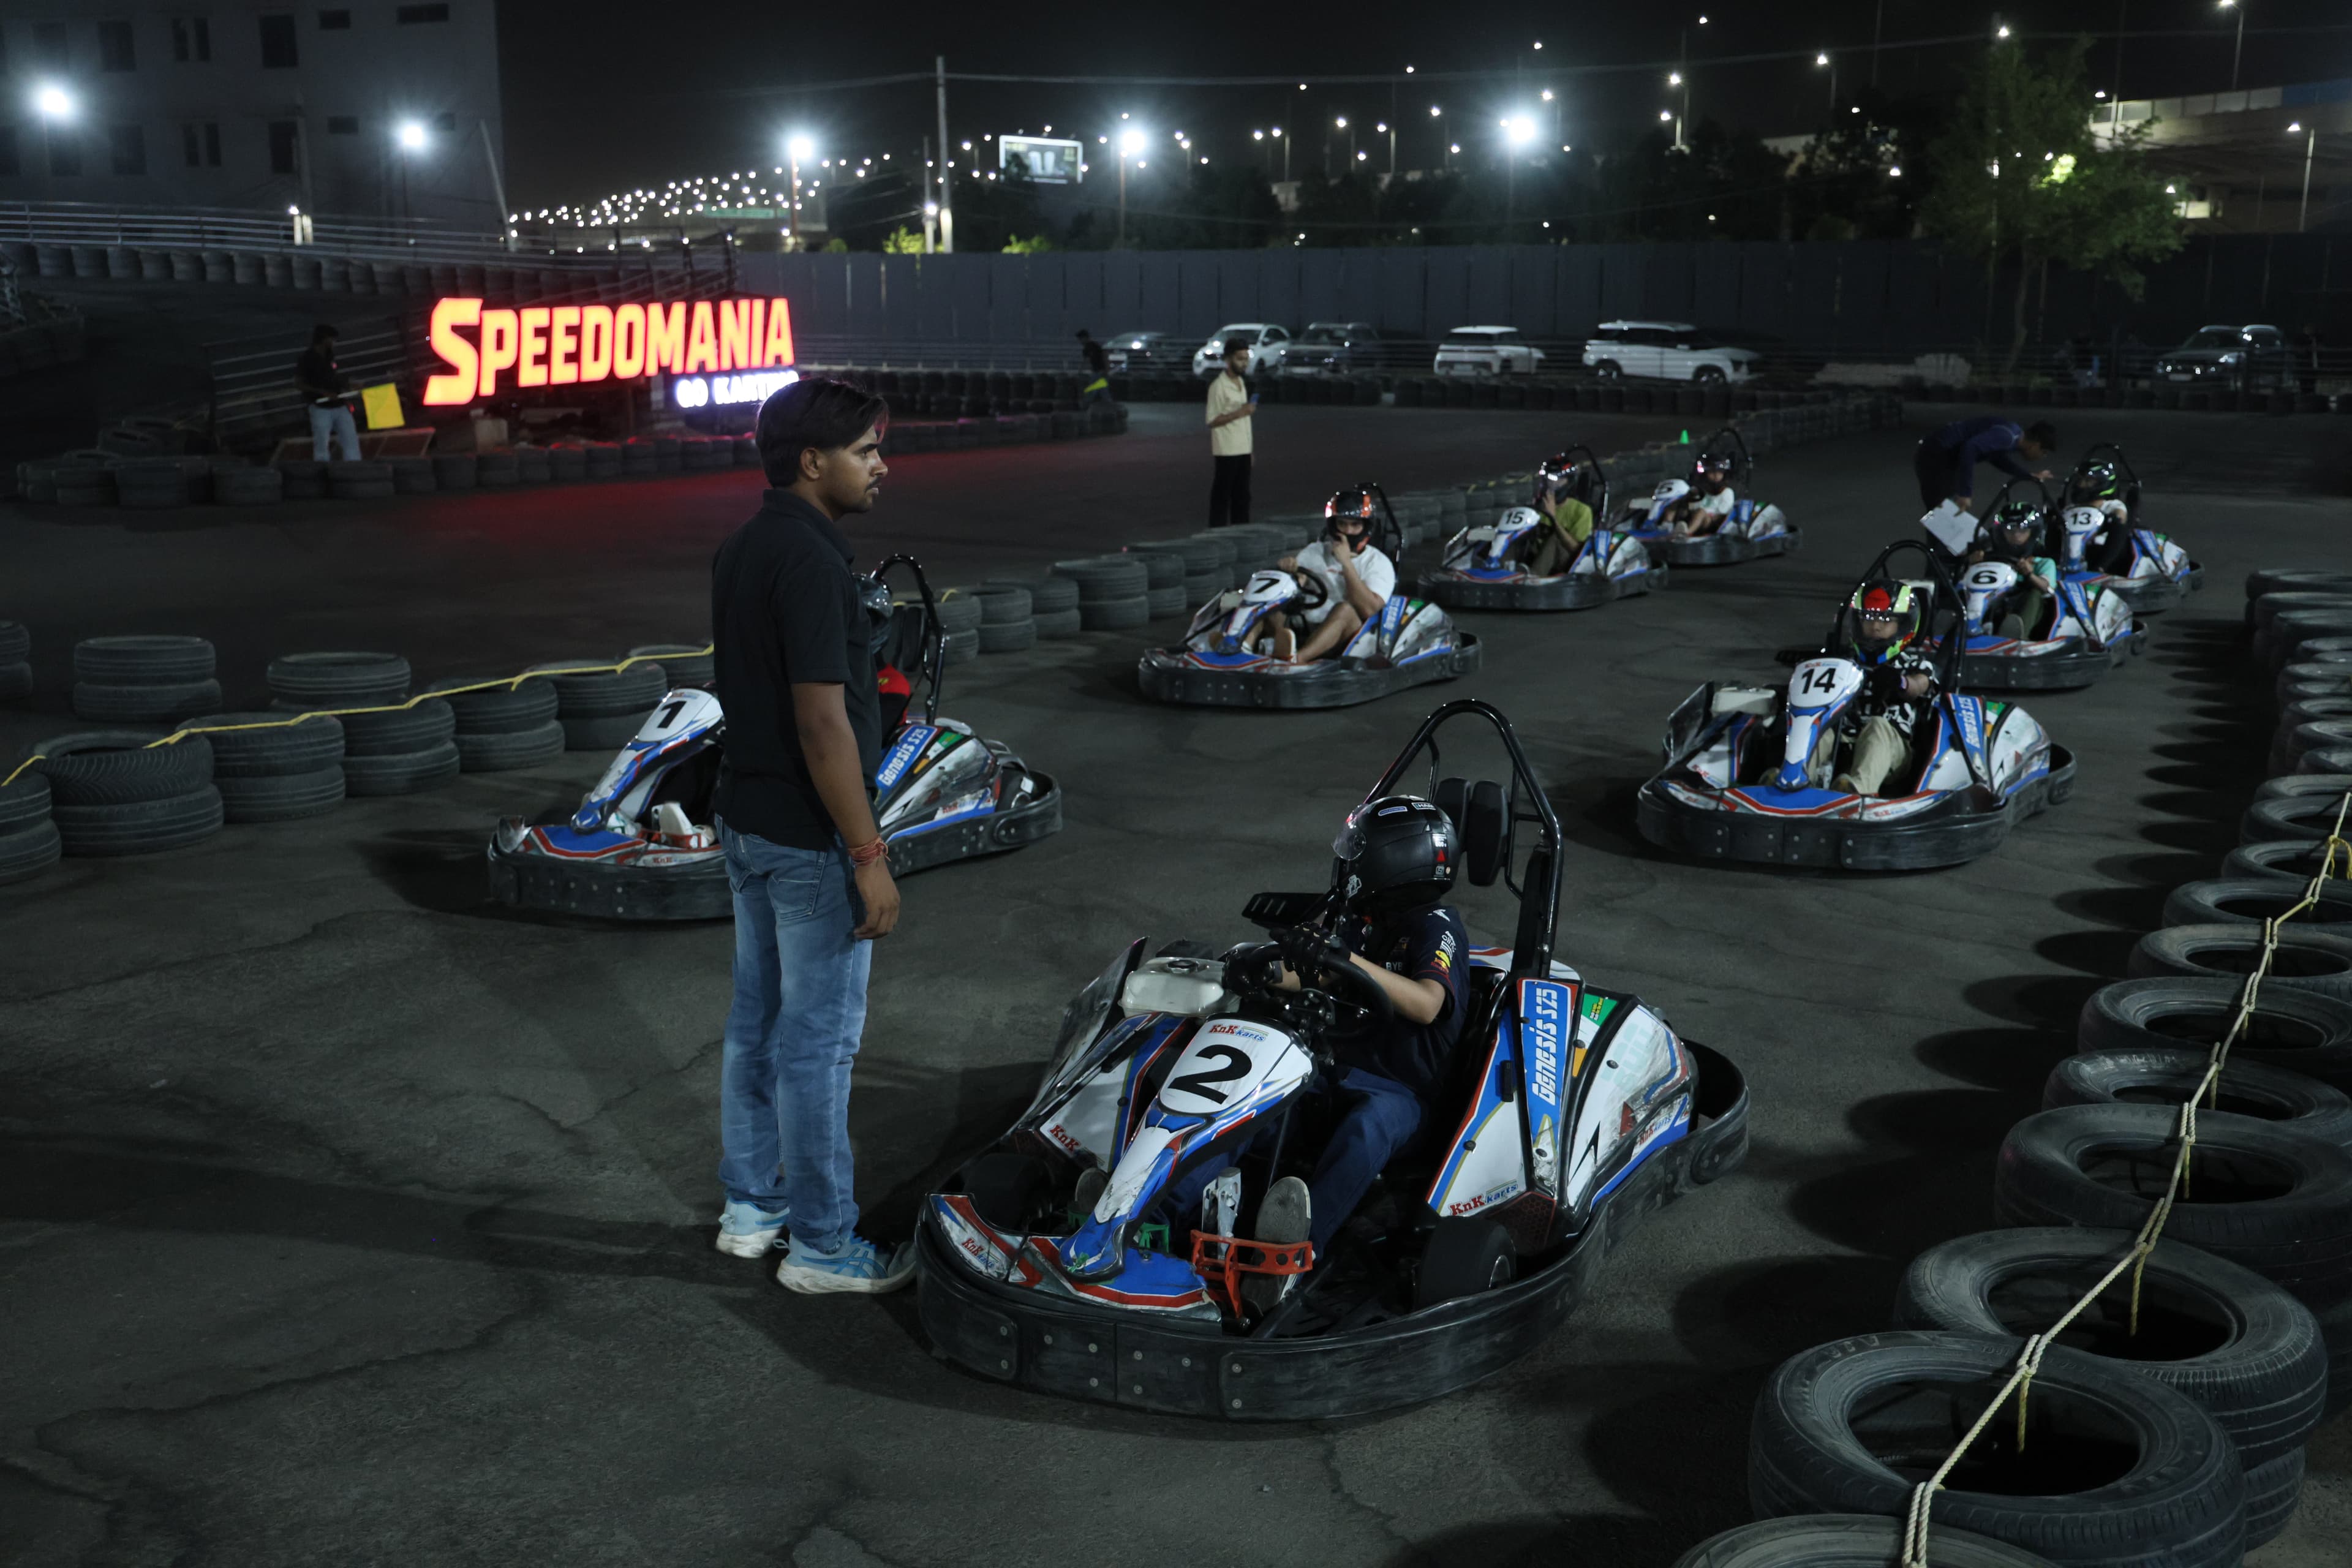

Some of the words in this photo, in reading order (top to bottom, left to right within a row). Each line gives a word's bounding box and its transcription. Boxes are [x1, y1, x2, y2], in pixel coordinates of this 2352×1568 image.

[423, 298, 794, 405] SPEEDOMANIA
[1506, 511, 1525, 524] 15
[2071, 512, 2091, 525] 13
[1254, 578, 1280, 593] 7
[1972, 570, 1997, 584] 6
[1801, 668, 1836, 694] 14
[657, 700, 687, 729] 1
[1536, 987, 1558, 1019] S25
[1209, 1024, 1240, 1035] KnK
[1235, 1029, 1266, 1042] karts
[1167, 1044, 1253, 1105] 2
[1449, 1195, 1485, 1216] KnK
[1487, 1183, 1518, 1204] karts
